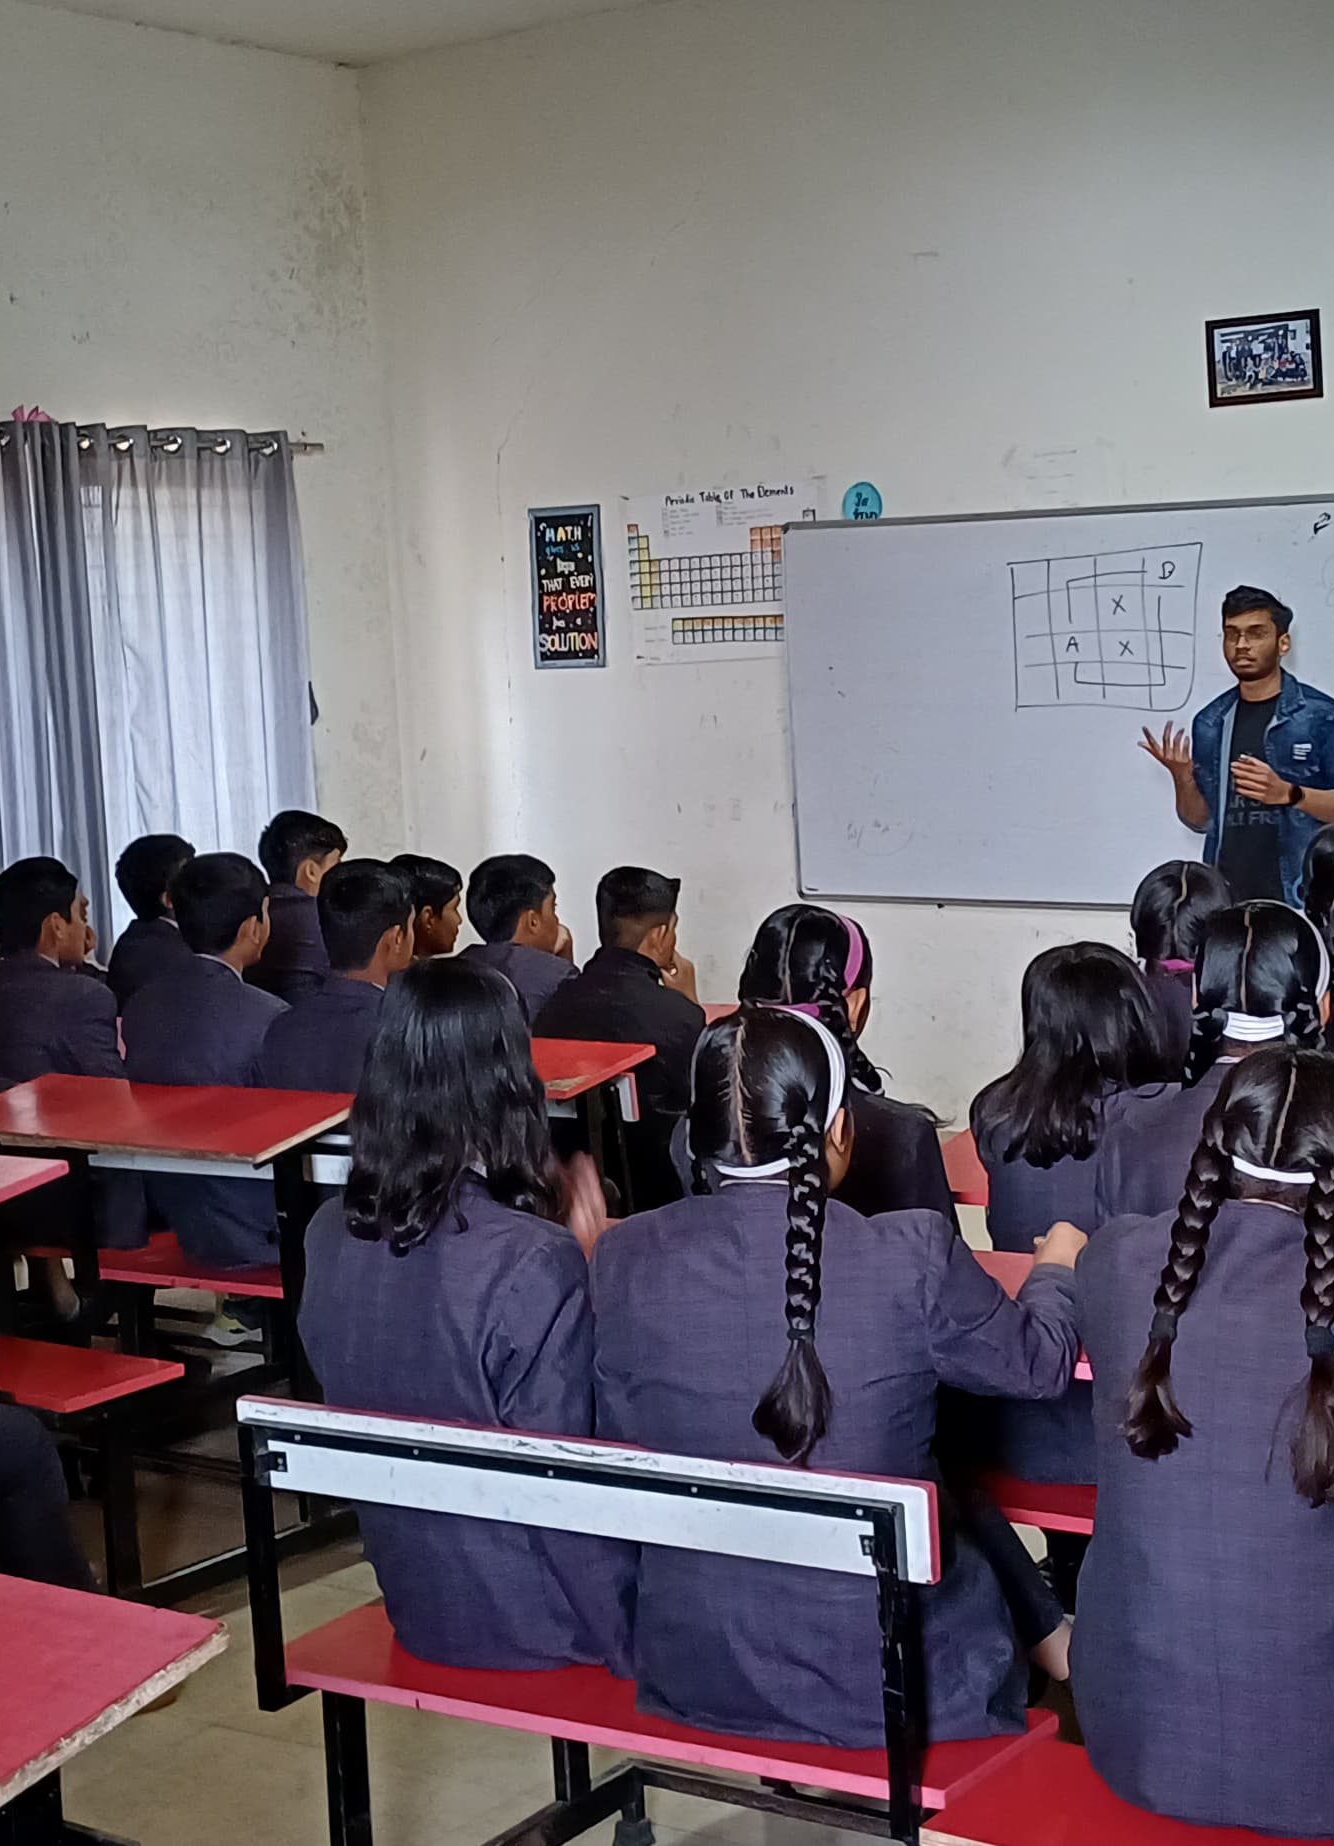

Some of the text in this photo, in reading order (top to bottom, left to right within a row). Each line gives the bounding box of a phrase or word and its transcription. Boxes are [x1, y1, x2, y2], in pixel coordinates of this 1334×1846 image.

[740, 488, 755, 500] The
[542, 573, 594, 592] THAT EVERY
[539, 632, 598, 652] SOLUTION
[1066, 636, 1079, 653] A
